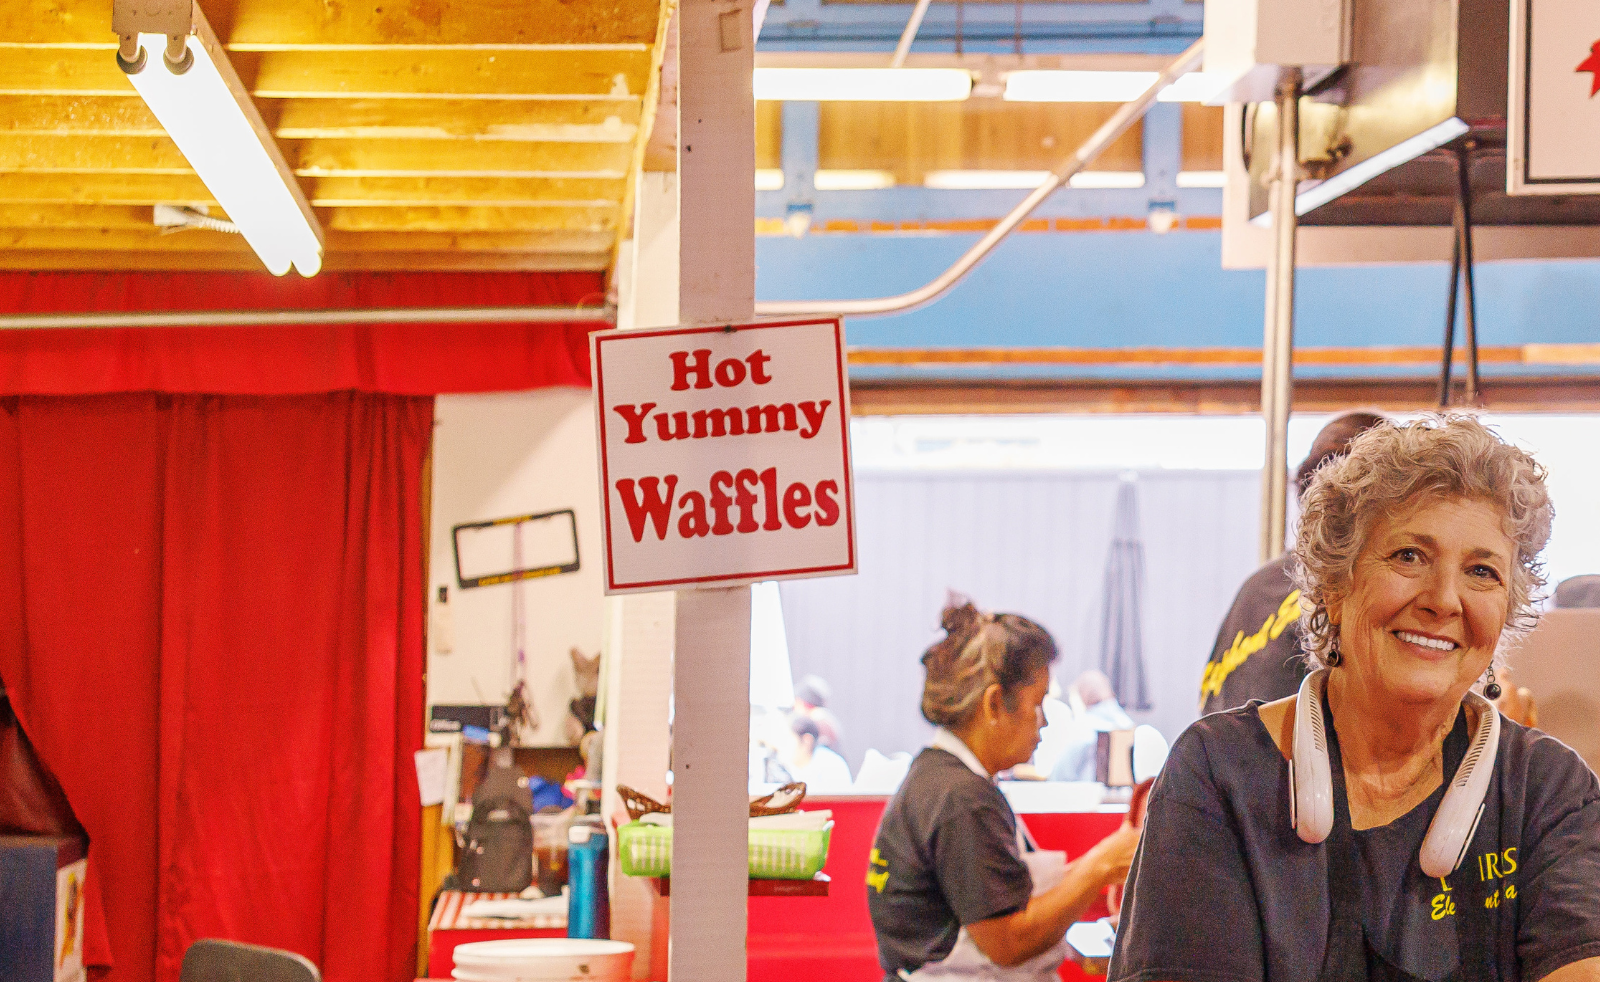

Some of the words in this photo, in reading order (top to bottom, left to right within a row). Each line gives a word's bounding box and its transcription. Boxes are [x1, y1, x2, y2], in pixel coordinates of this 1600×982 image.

[668, 349, 773, 391] Hot
[613, 399, 832, 444] Yummy
[615, 466, 840, 543] Waffles
